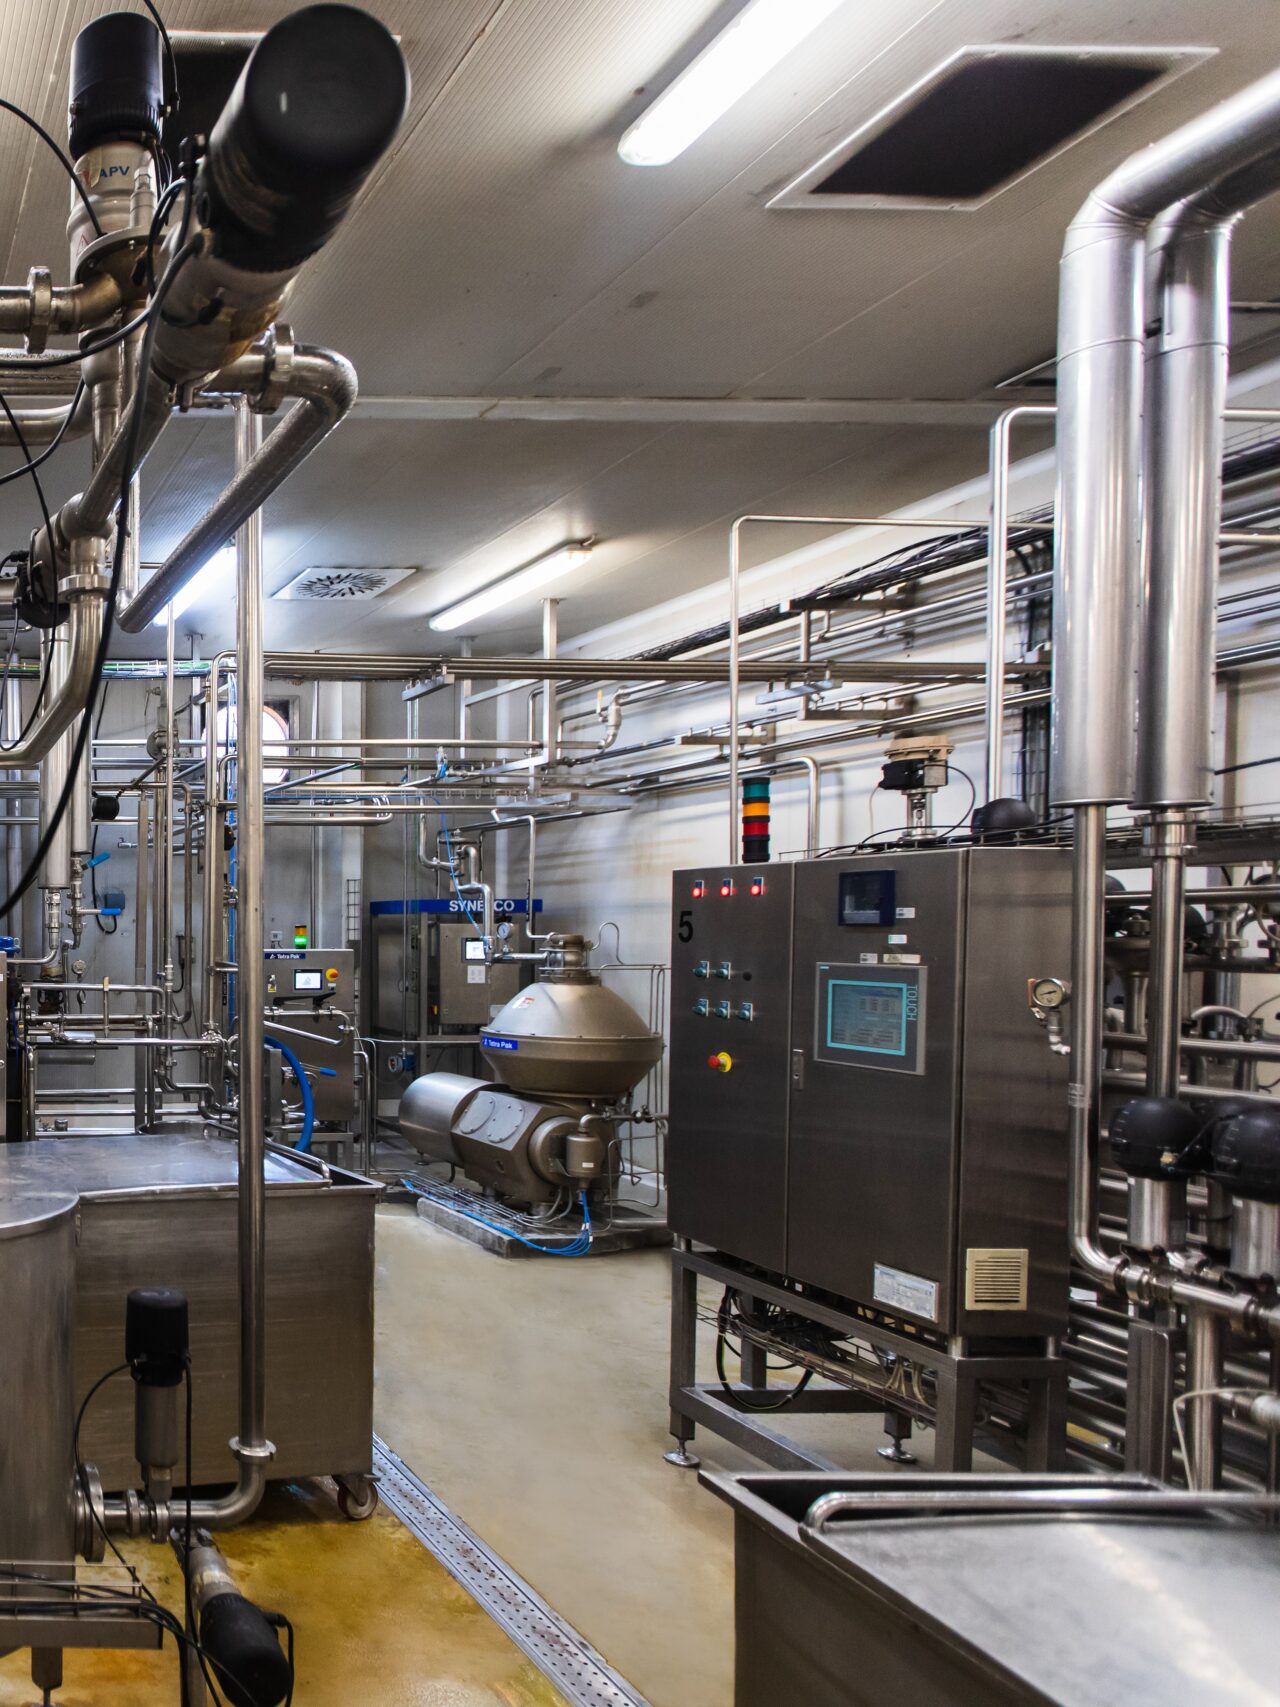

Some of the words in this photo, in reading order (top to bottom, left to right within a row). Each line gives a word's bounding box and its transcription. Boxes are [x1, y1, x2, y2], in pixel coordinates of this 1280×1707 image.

[100, 166, 130, 178] APV
[449, 899, 515, 912] SYNECO
[678, 910, 694, 943] 5
[906, 984, 918, 1021] TOUCH
